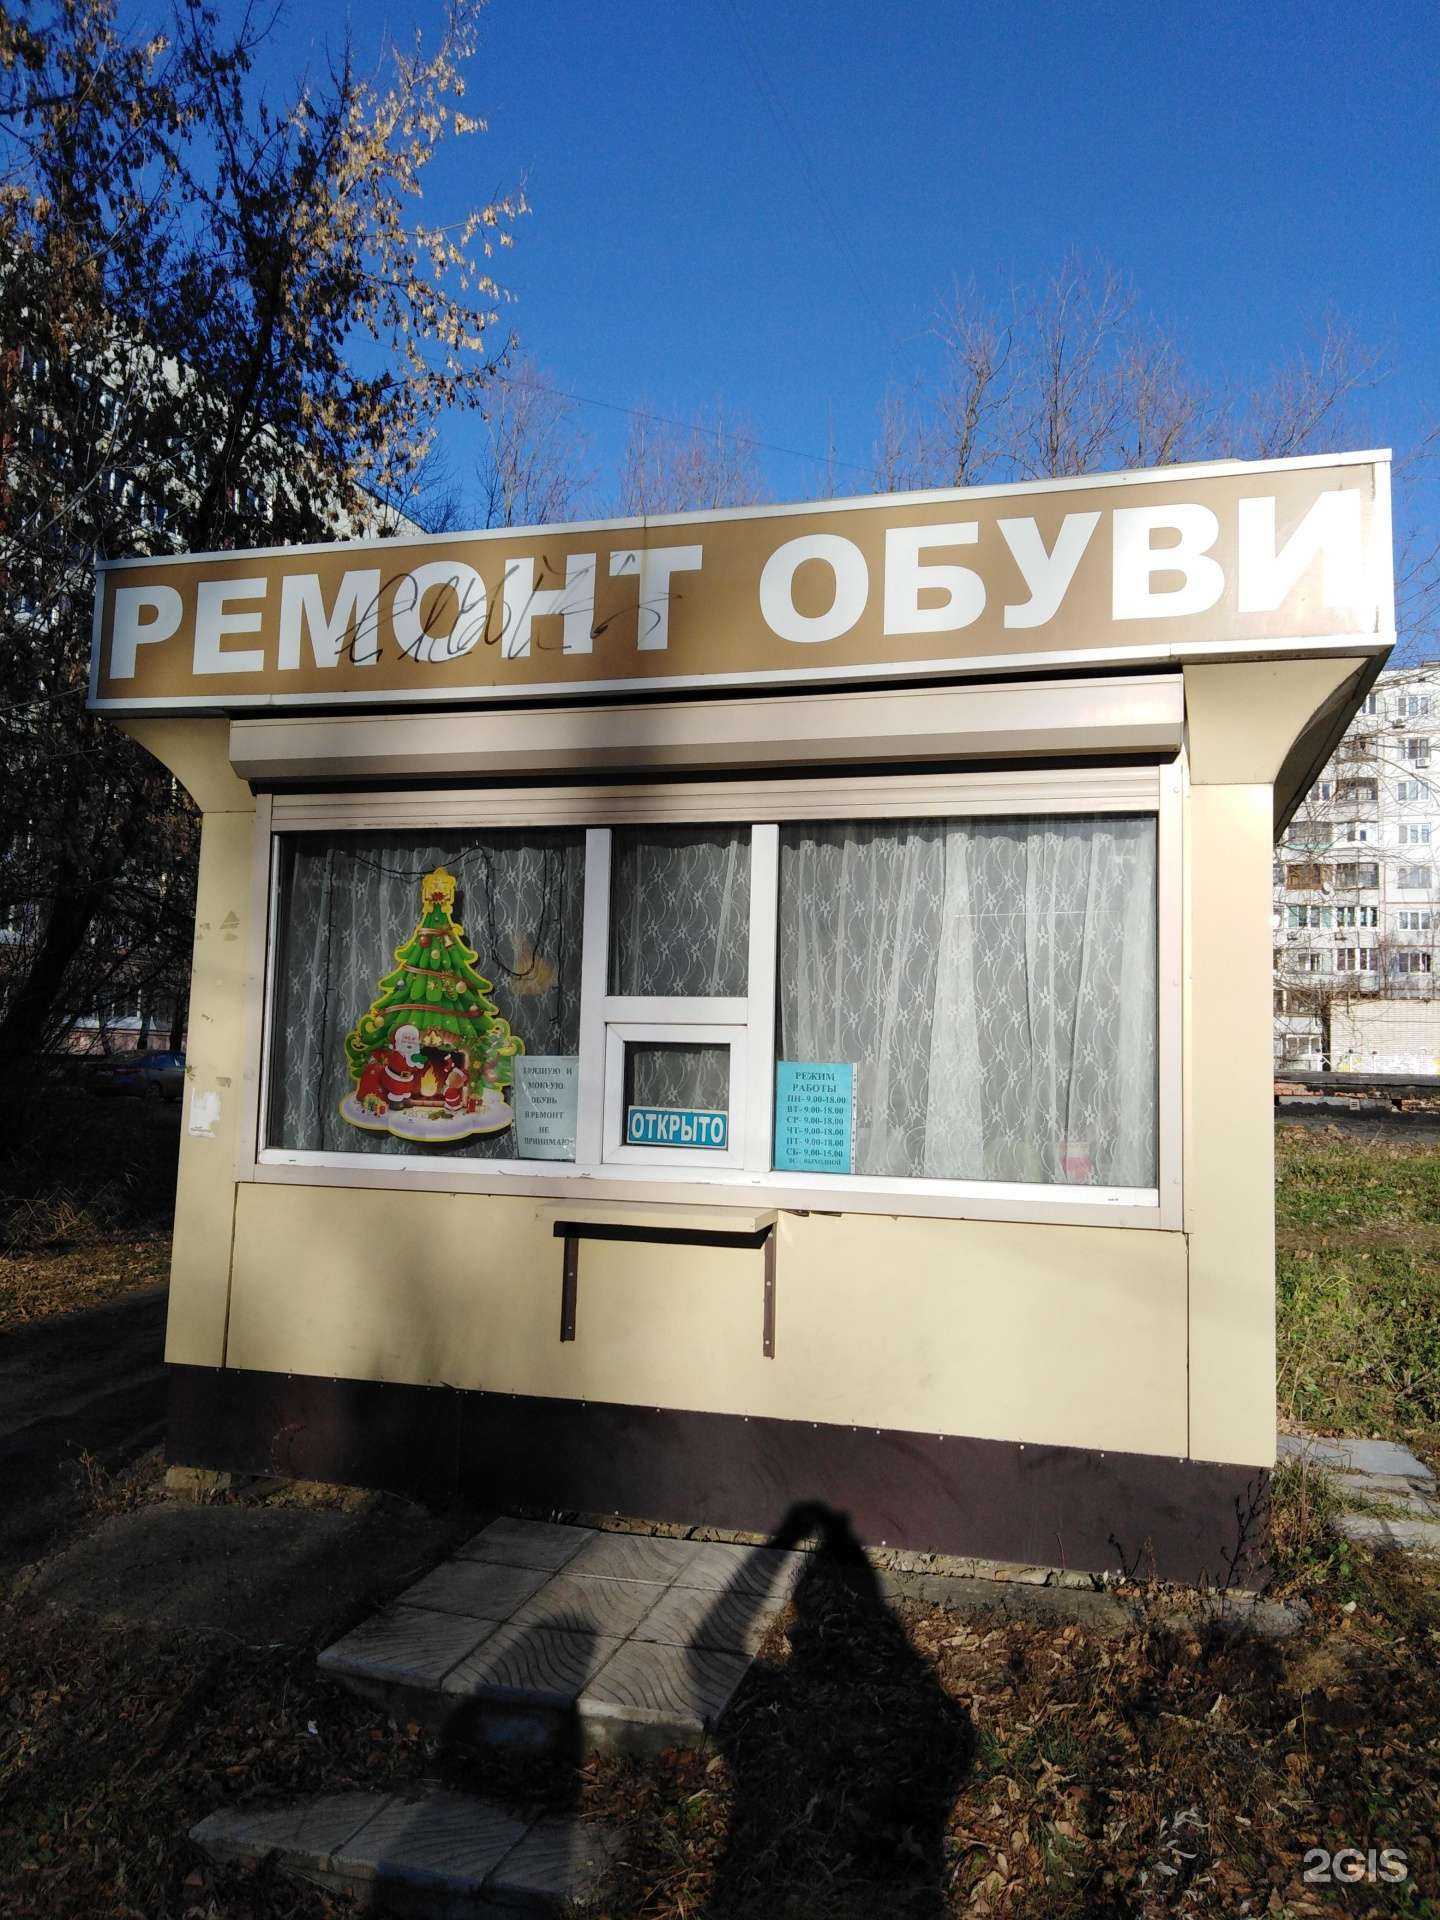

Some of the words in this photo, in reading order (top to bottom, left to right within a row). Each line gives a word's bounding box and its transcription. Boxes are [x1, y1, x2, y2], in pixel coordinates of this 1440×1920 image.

[109, 545, 703, 680] РЕМОНТ
[759, 488, 1361, 643] ОБУВИ
[795, 1072, 835, 1081] РЕЖИМ
[792, 1083, 837, 1093] РАБОТЫ
[530, 1111, 563, 1119] РЕМОНТ
[631, 1112, 724, 1143] ОТКРЫТО
